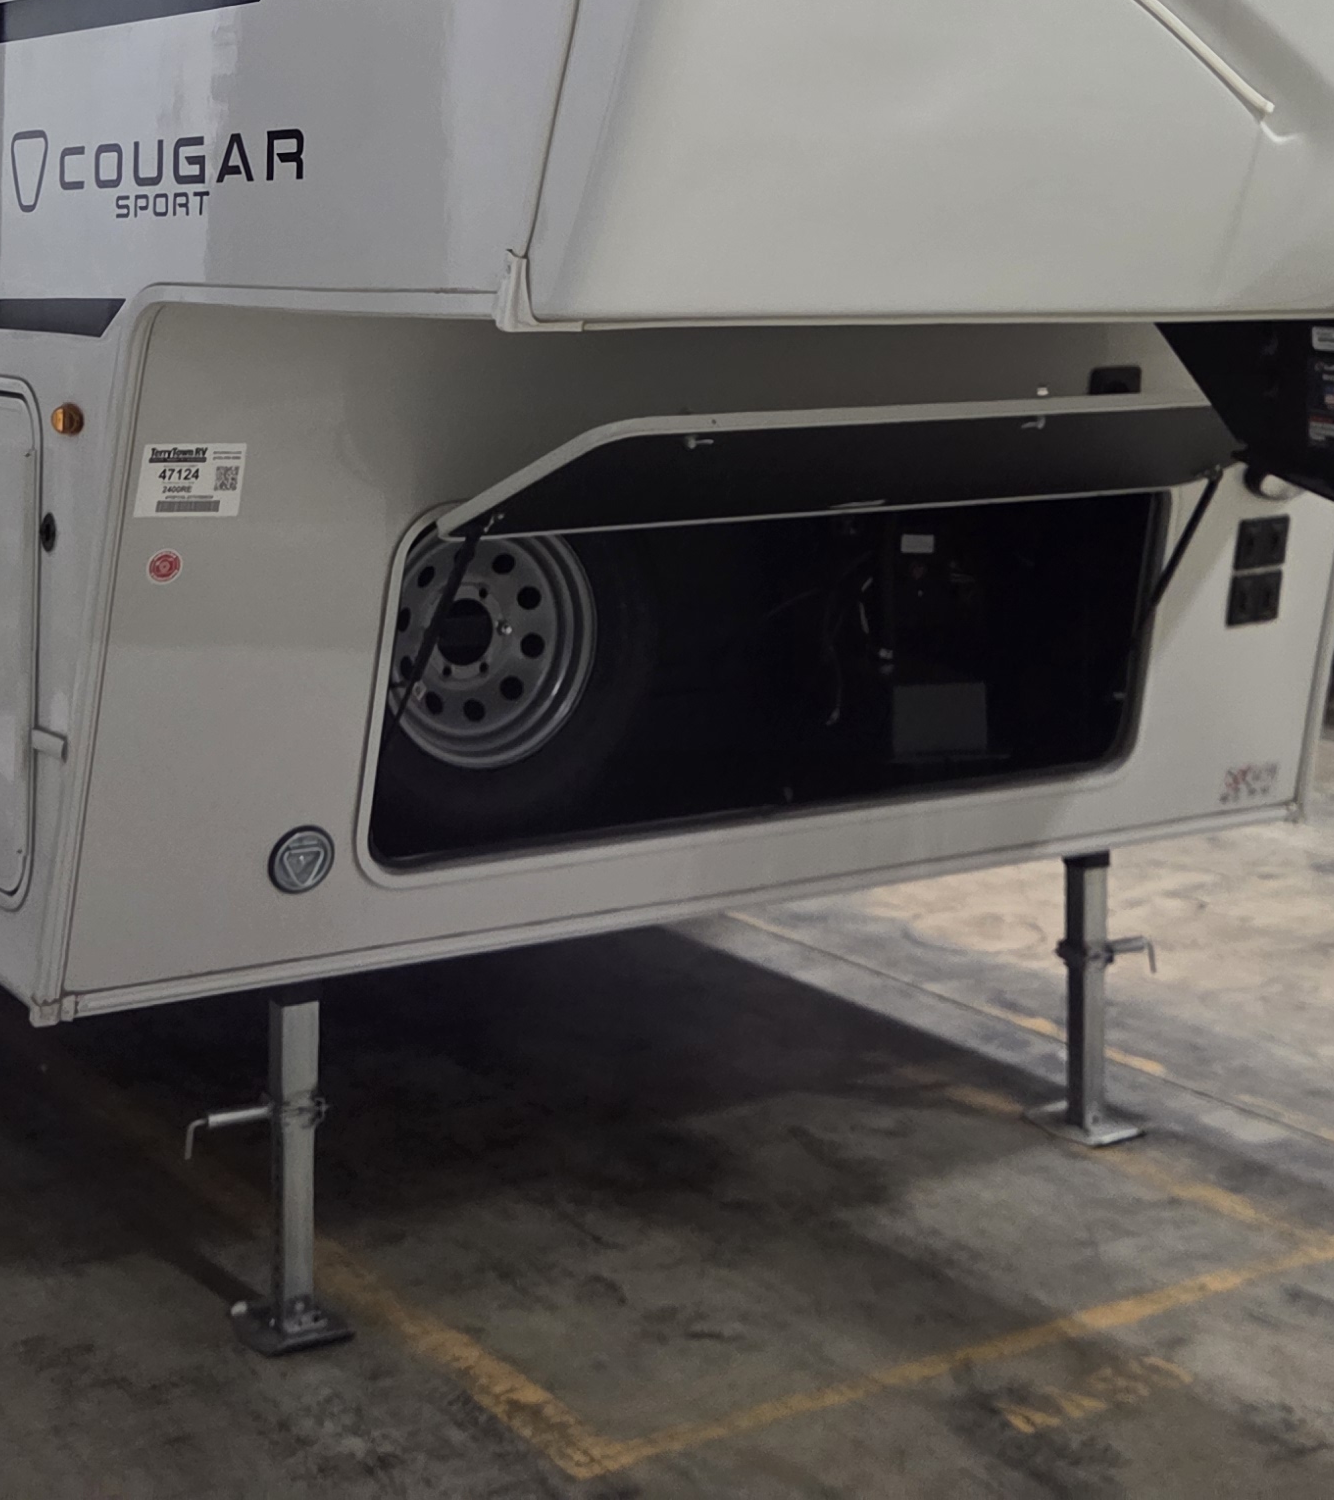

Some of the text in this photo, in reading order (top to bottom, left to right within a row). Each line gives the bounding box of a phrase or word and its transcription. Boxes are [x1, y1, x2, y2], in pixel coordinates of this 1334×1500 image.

[59, 128, 305, 190] COUGAR
[115, 190, 211, 219] SPORT
[158, 468, 200, 481] 47124
